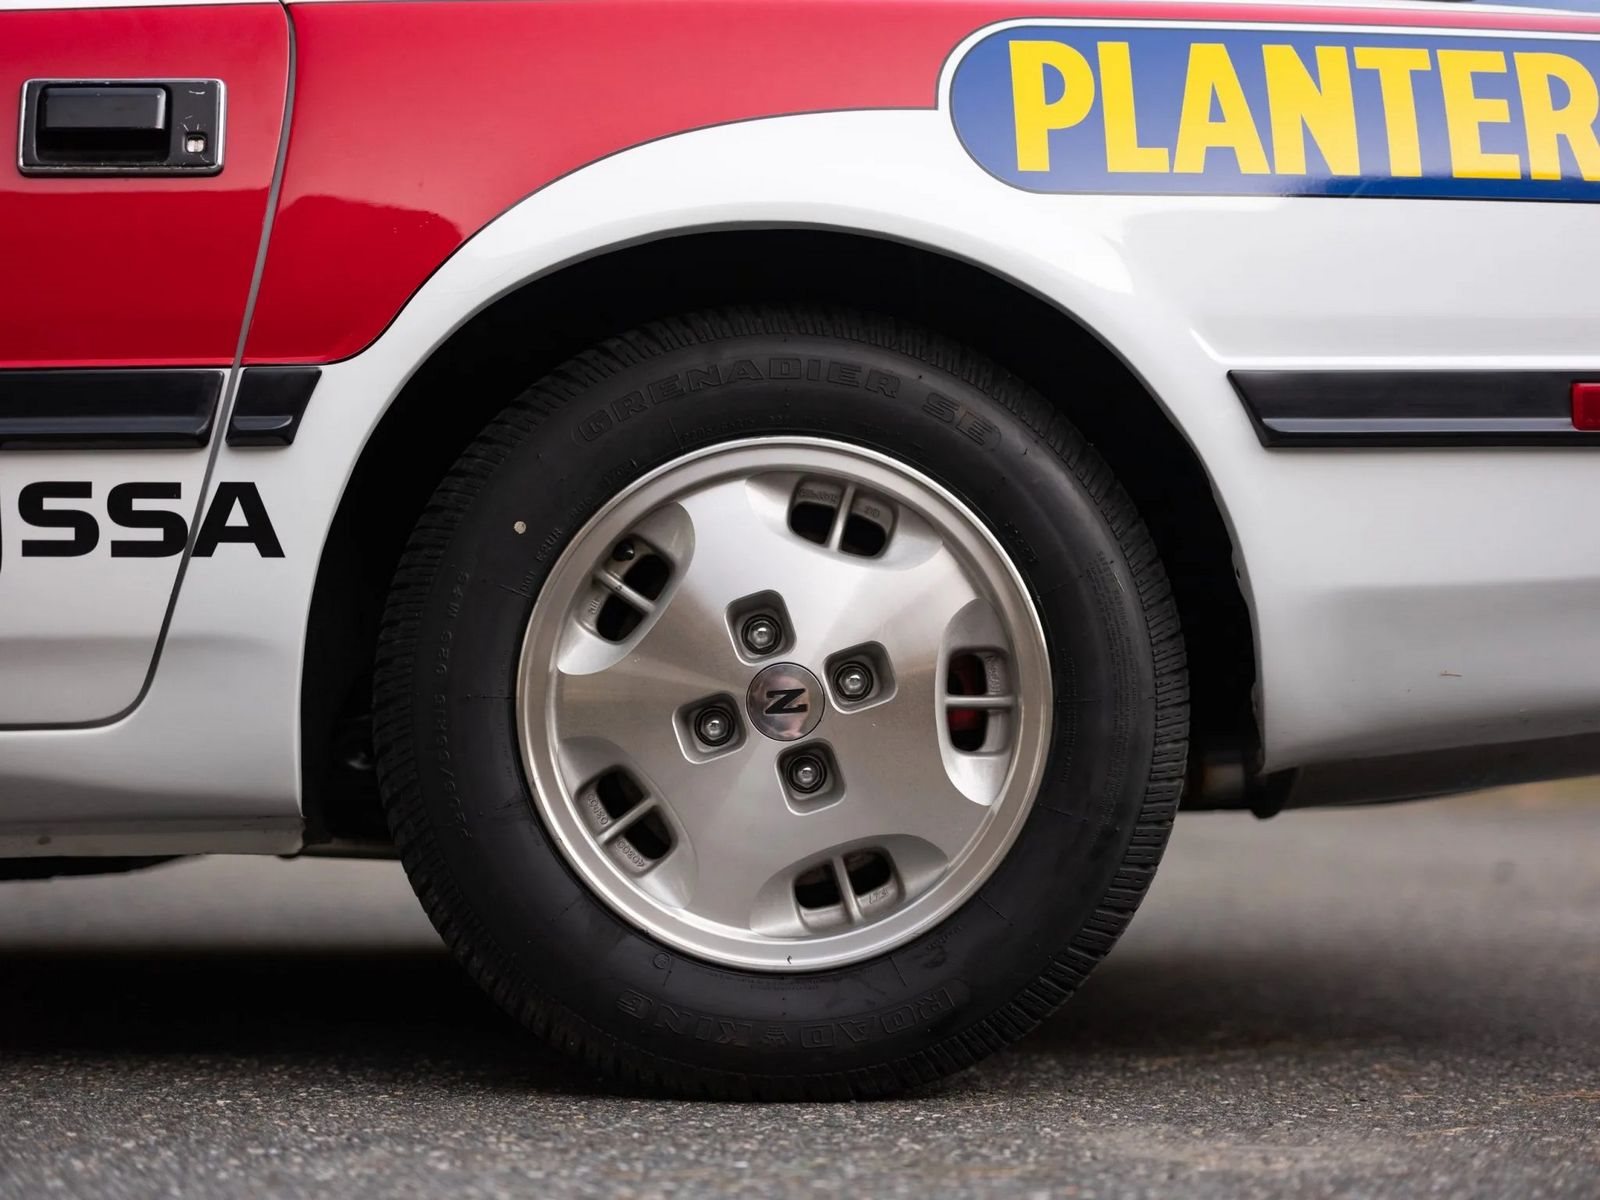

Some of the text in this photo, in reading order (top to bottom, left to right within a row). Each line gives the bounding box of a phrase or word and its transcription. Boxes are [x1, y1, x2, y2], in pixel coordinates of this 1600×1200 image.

[1008, 40, 1600, 180] PLANTER
[577, 358, 901, 442] GRENADIER
[922, 390, 995, 446] SE
[615, 987, 956, 1049] ROAD KING
